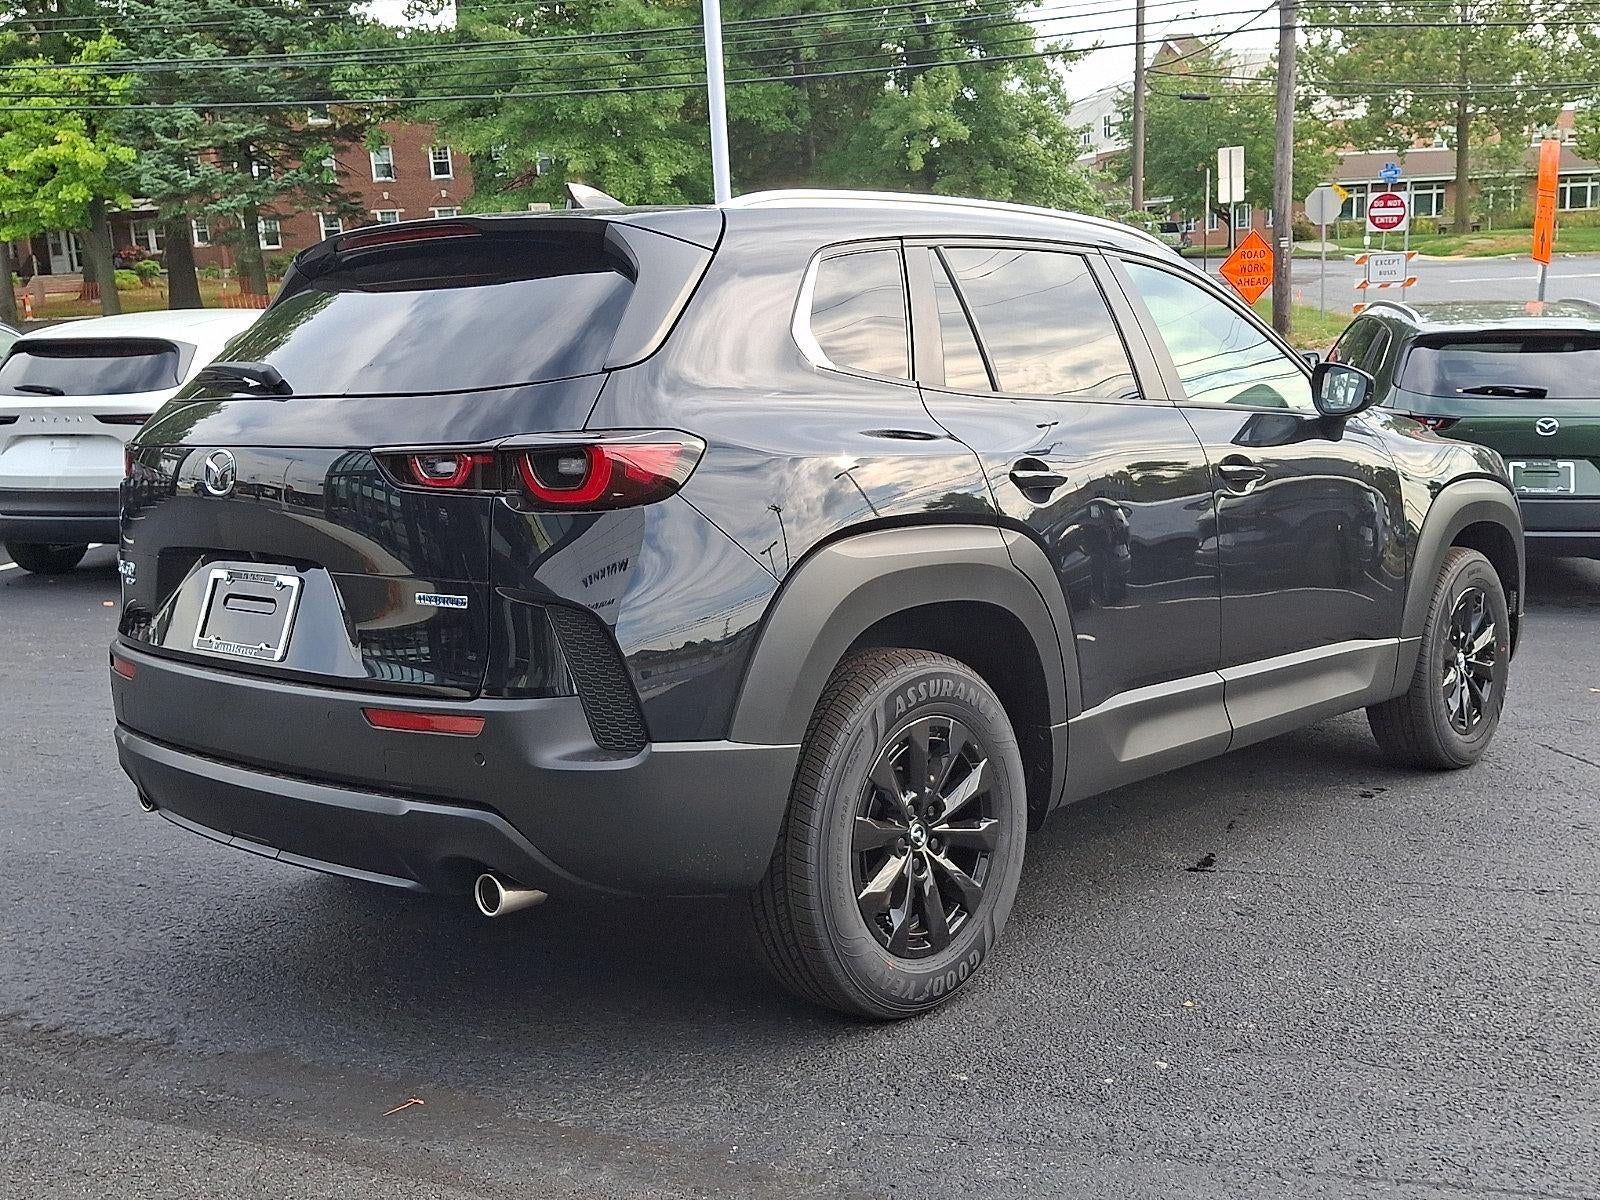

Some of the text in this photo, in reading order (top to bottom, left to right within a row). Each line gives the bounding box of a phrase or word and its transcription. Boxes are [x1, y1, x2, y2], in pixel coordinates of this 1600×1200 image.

[1375, 216, 1398, 224] ENTER
[1240, 250, 1266, 259] ROAD
[1240, 263, 1266, 273] WORK
[1237, 277, 1269, 287] AHEAD
[417, 594, 467, 606] HYBRID
[211, 641, 258, 656] Faulkner
